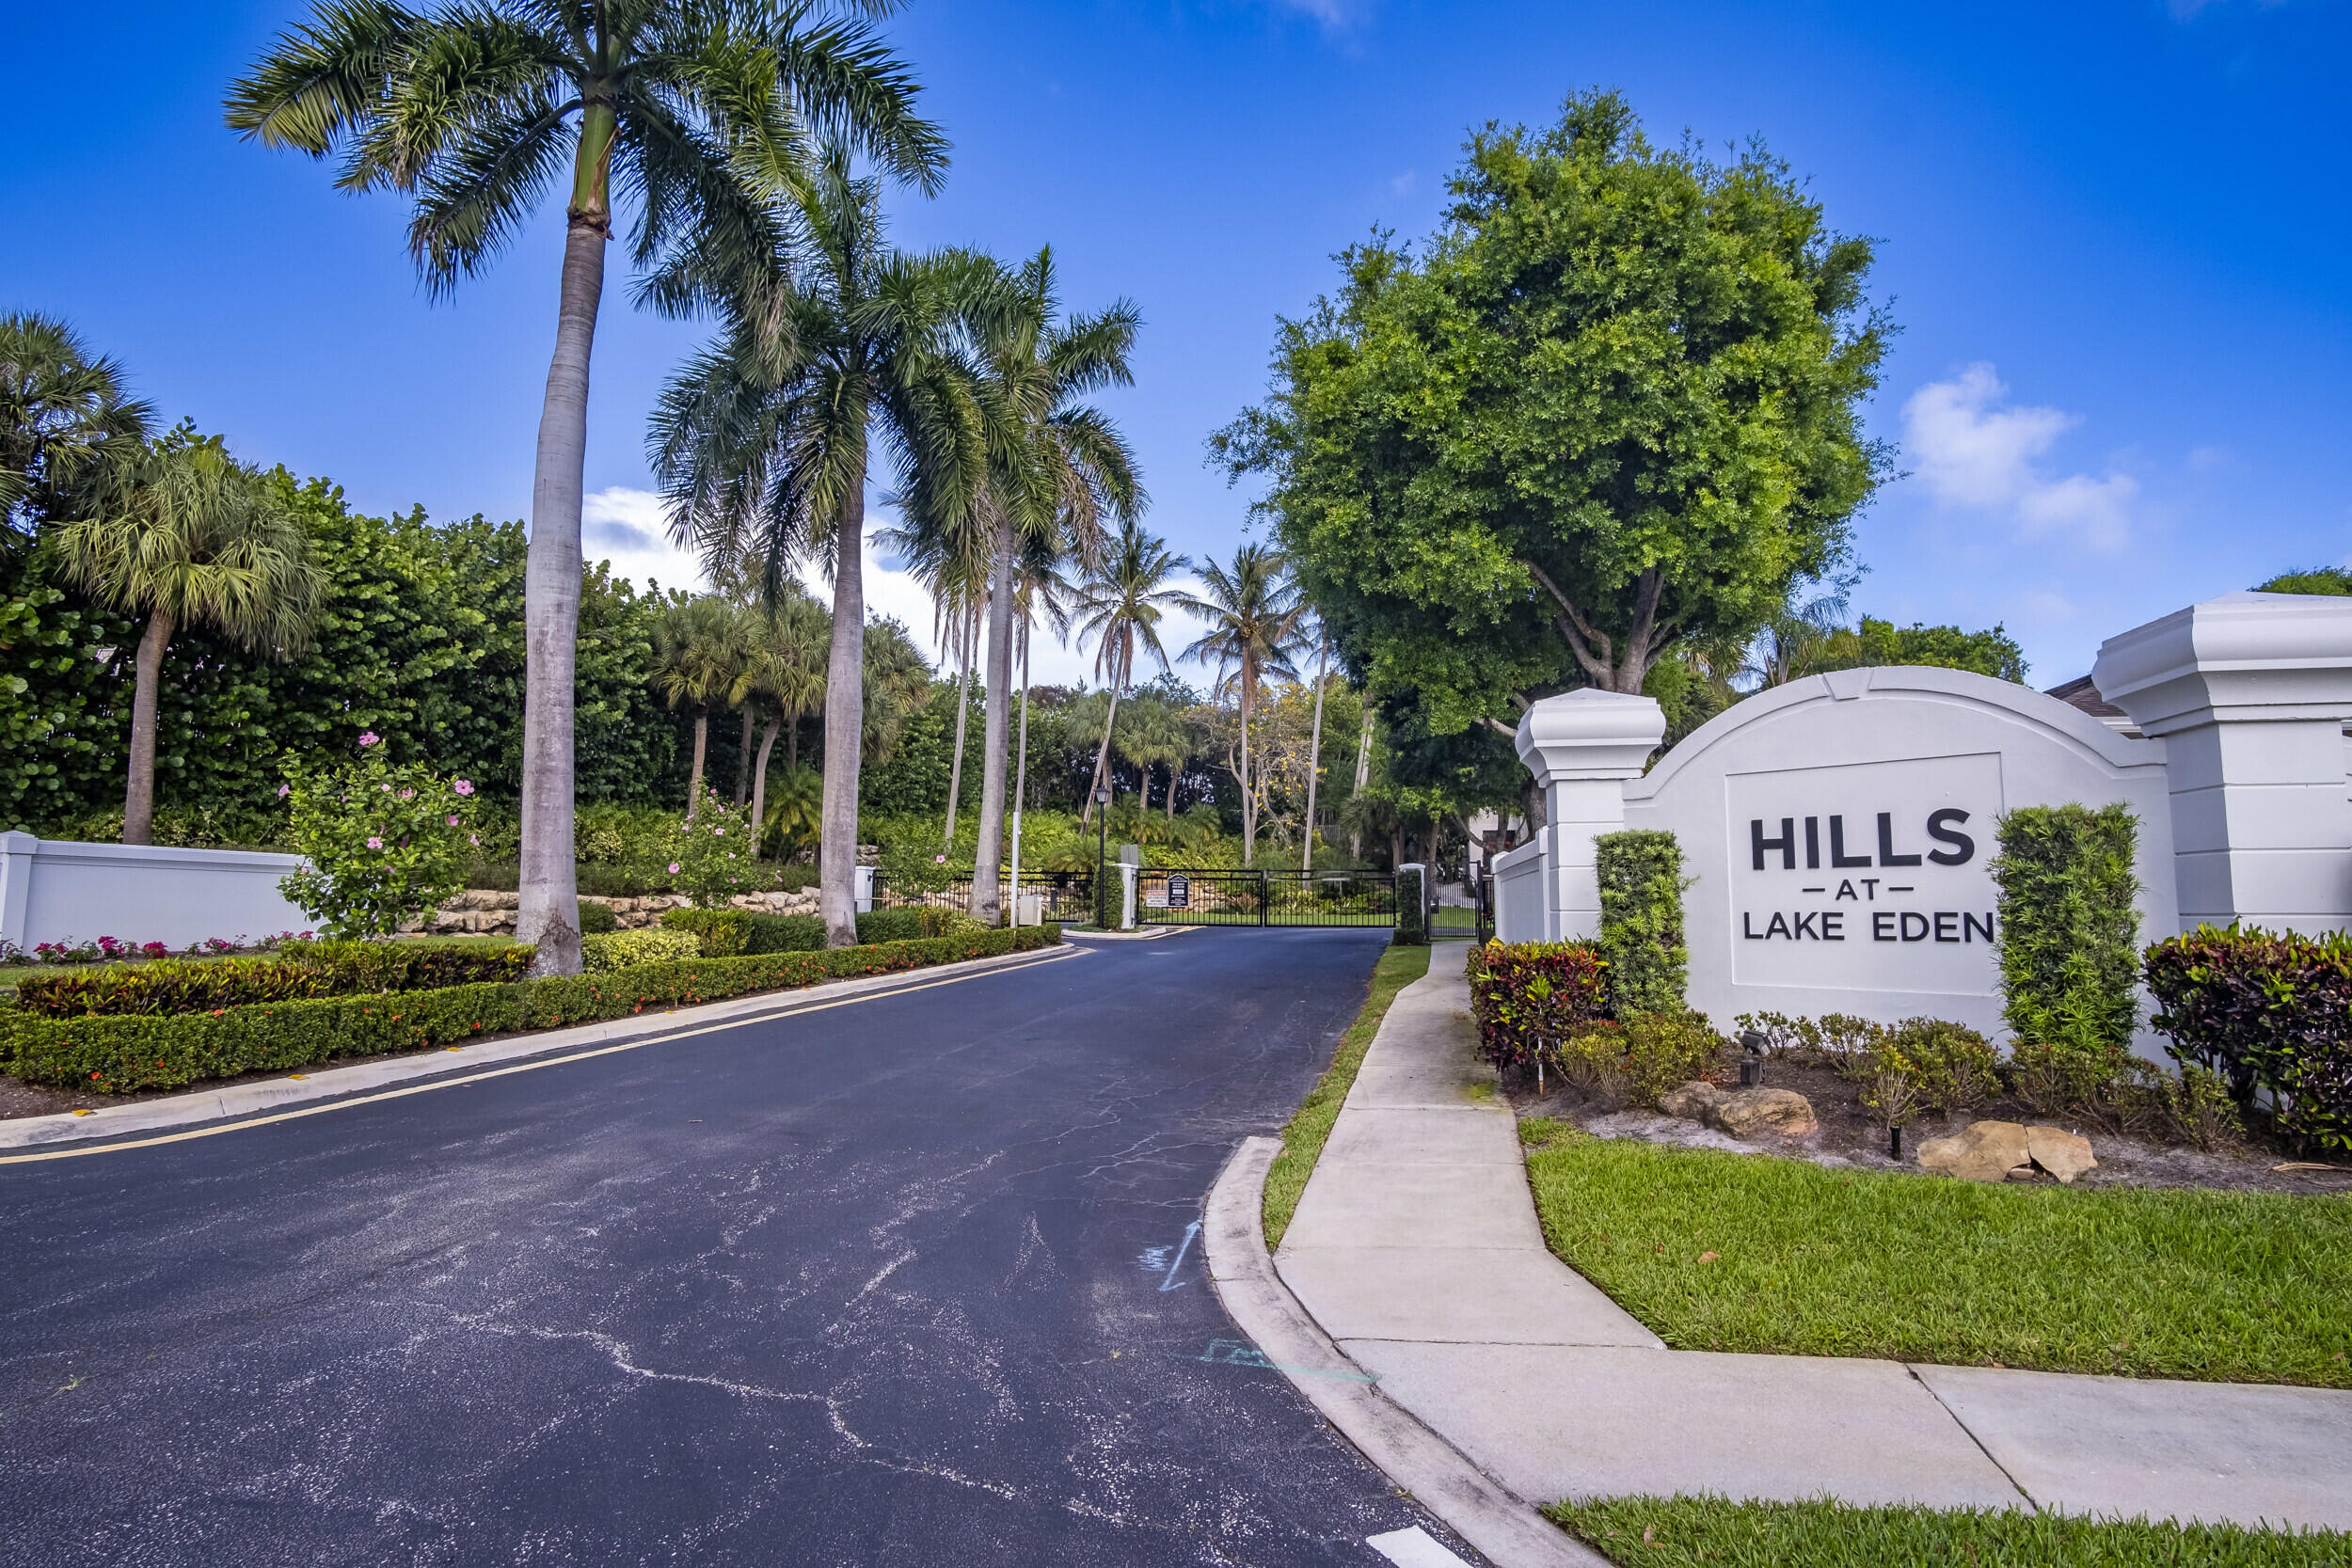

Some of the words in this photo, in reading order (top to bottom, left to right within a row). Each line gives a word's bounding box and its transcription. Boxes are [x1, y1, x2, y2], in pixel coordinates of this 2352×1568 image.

[1750, 808, 1976, 870] HILLS
[1835, 879, 1881, 901] AT
[1743, 911, 1845, 942] LAKE
[1872, 911, 1994, 942] EDEN
